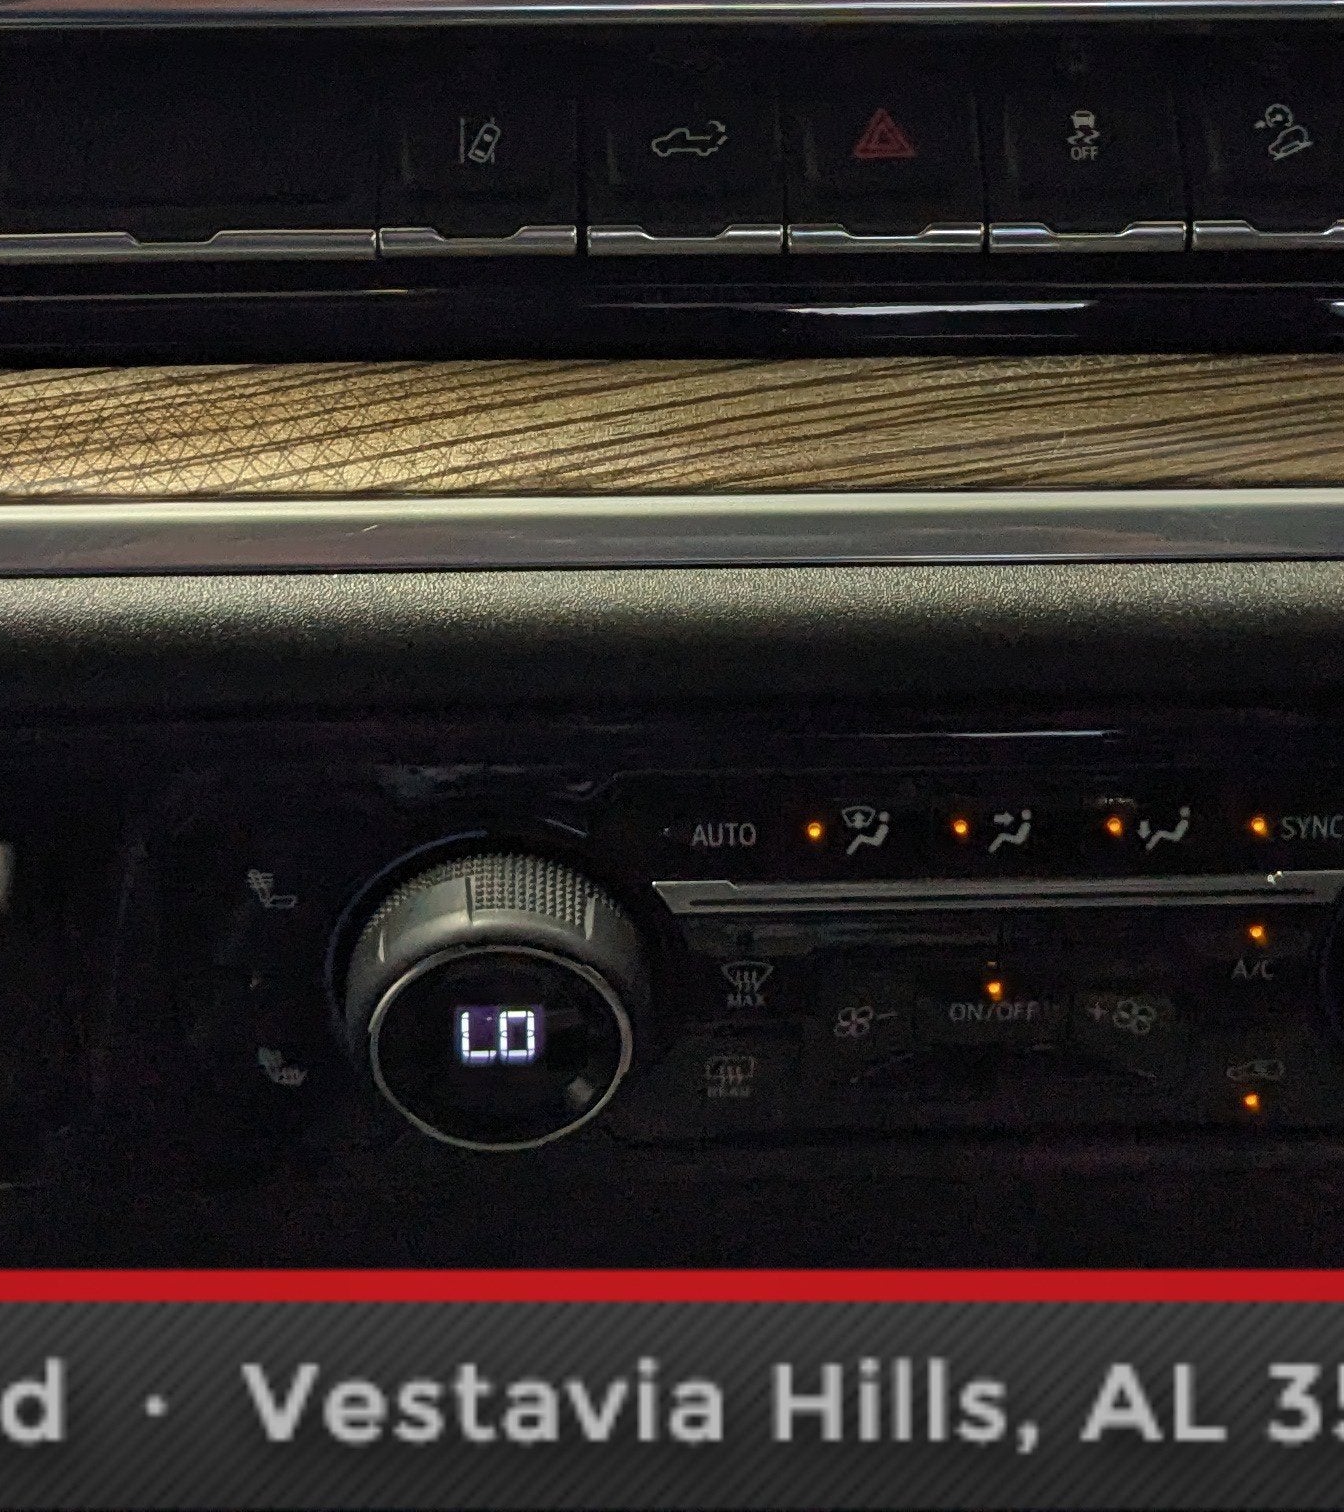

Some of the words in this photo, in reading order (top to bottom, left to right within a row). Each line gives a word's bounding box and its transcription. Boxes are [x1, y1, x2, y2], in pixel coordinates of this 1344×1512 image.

[1070, 145, 1099, 162] OFF
[691, 821, 757, 848] AUTO
[1280, 813, 1344, 841] SYNC
[1230, 959, 1274, 981] A/C
[725, 992, 767, 1009] MAX
[948, 1001, 1036, 1023] ON/OFF
